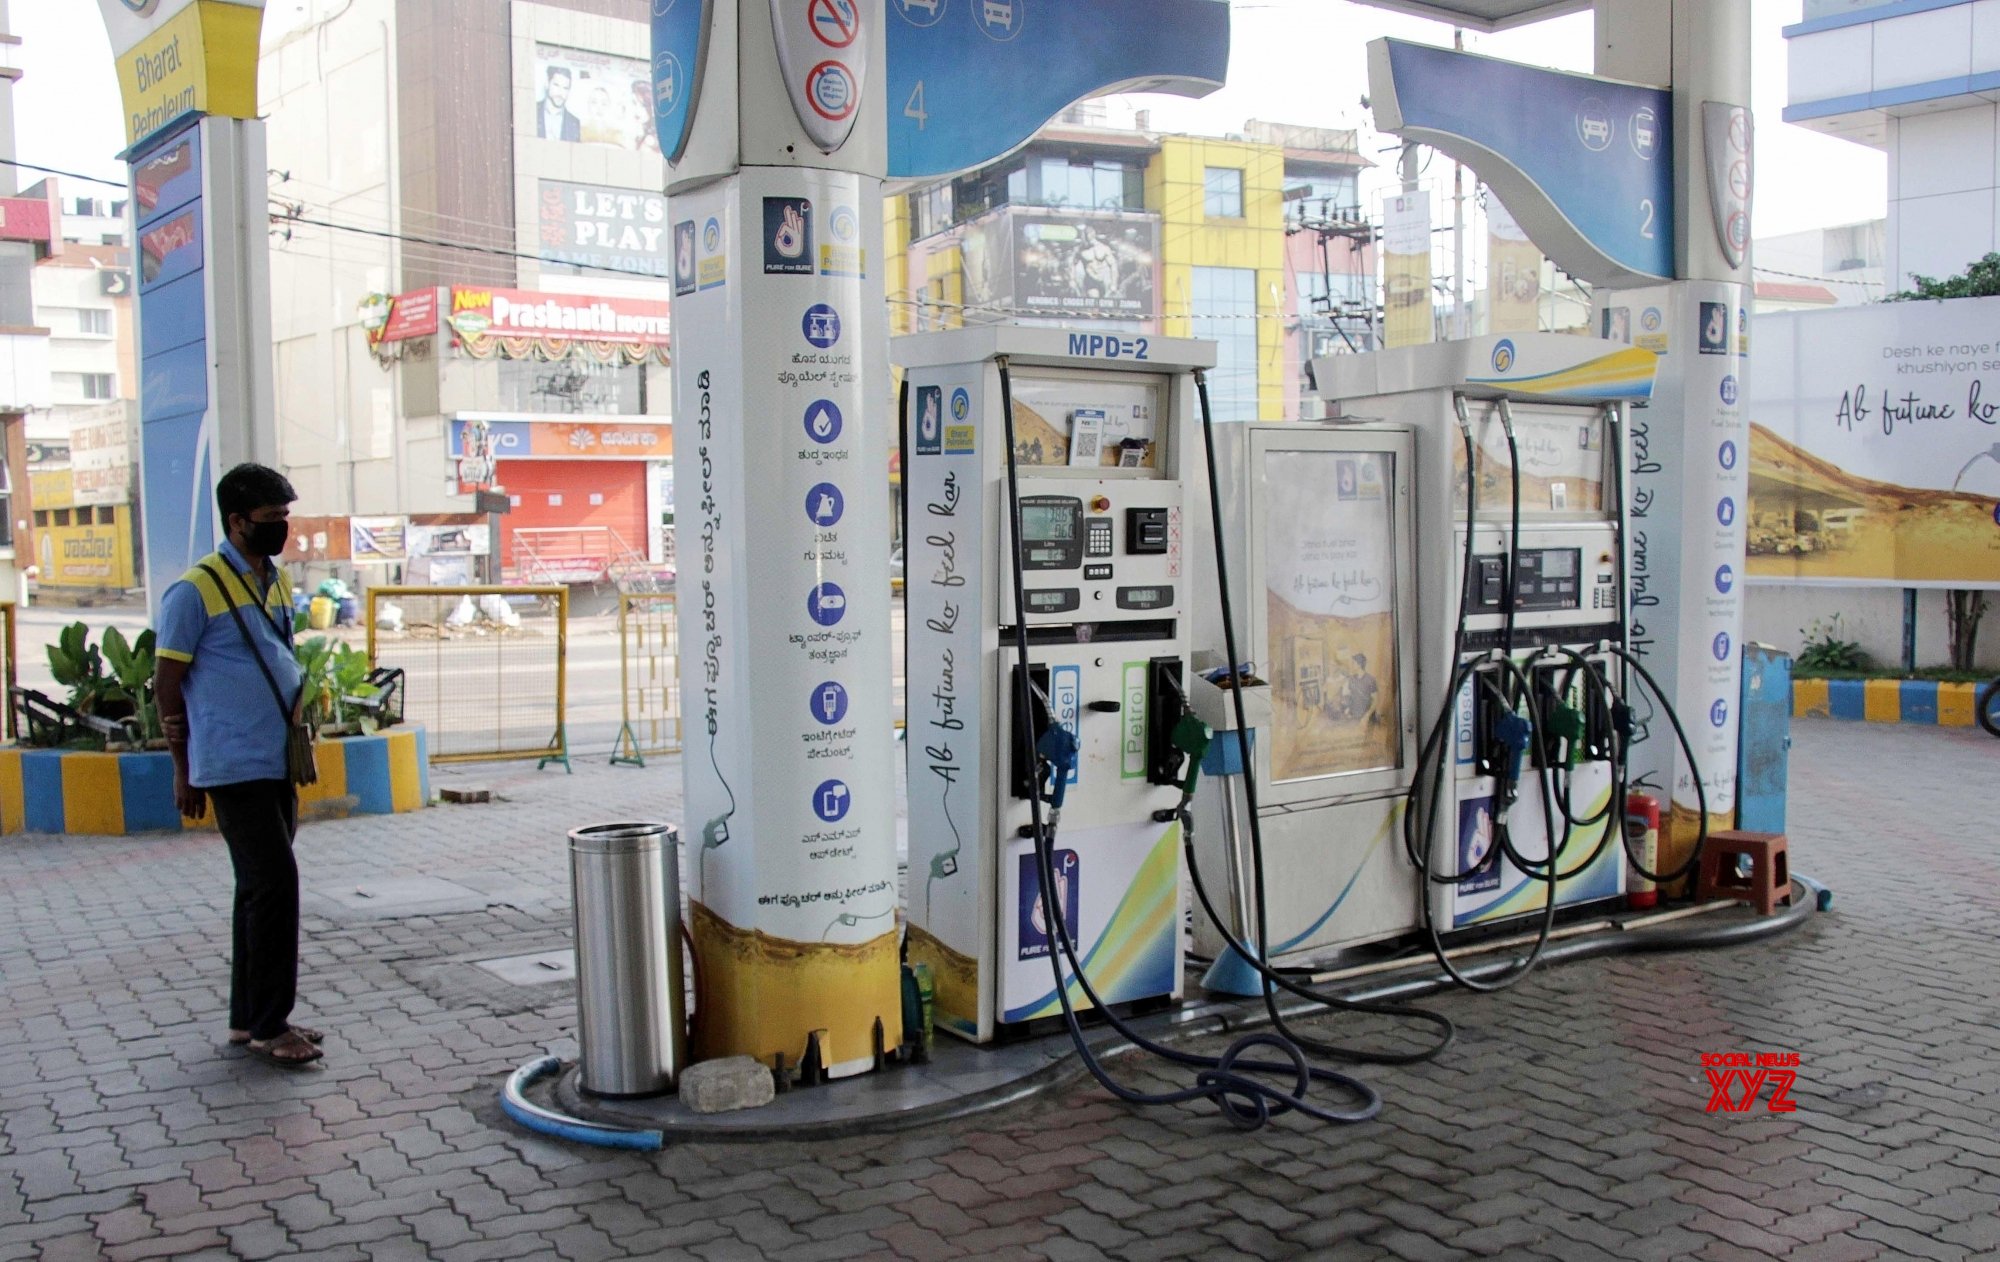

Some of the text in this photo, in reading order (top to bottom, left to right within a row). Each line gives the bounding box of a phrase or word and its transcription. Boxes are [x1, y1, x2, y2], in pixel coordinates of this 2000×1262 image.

[135, 33, 182, 93] Bharat
[132, 85, 195, 141] Petroleum
[904, 80, 928, 131] 4
[574, 190, 664, 222] LET'S
[1640, 199, 1654, 239] 2
[574, 221, 663, 252] PLAY
[608, 255, 666, 276] ZONE
[454, 290, 492, 310] New
[492, 296, 616, 332] Prashanth
[617, 311, 669, 334] HOTE
[1069, 333, 1148, 360] MPD=2
[1883, 346, 1922, 358] Desh
[1927, 345, 1945, 356] ke
[1949, 343, 1990, 358] naye
[1897, 360, 1977, 376] khushiyon
[698, 369, 711, 441] ಮಾಡಿ
[1835, 379, 2000, 436] Ab future ko
[926, 531, 965, 587] feel
[927, 600, 959, 634] ko
[930, 648, 964, 731] future
[1058, 686, 1074, 735] esel
[1460, 680, 1473, 743] Diese
[1127, 685, 1144, 754] Petrol
[925, 742, 960, 782] Ab
